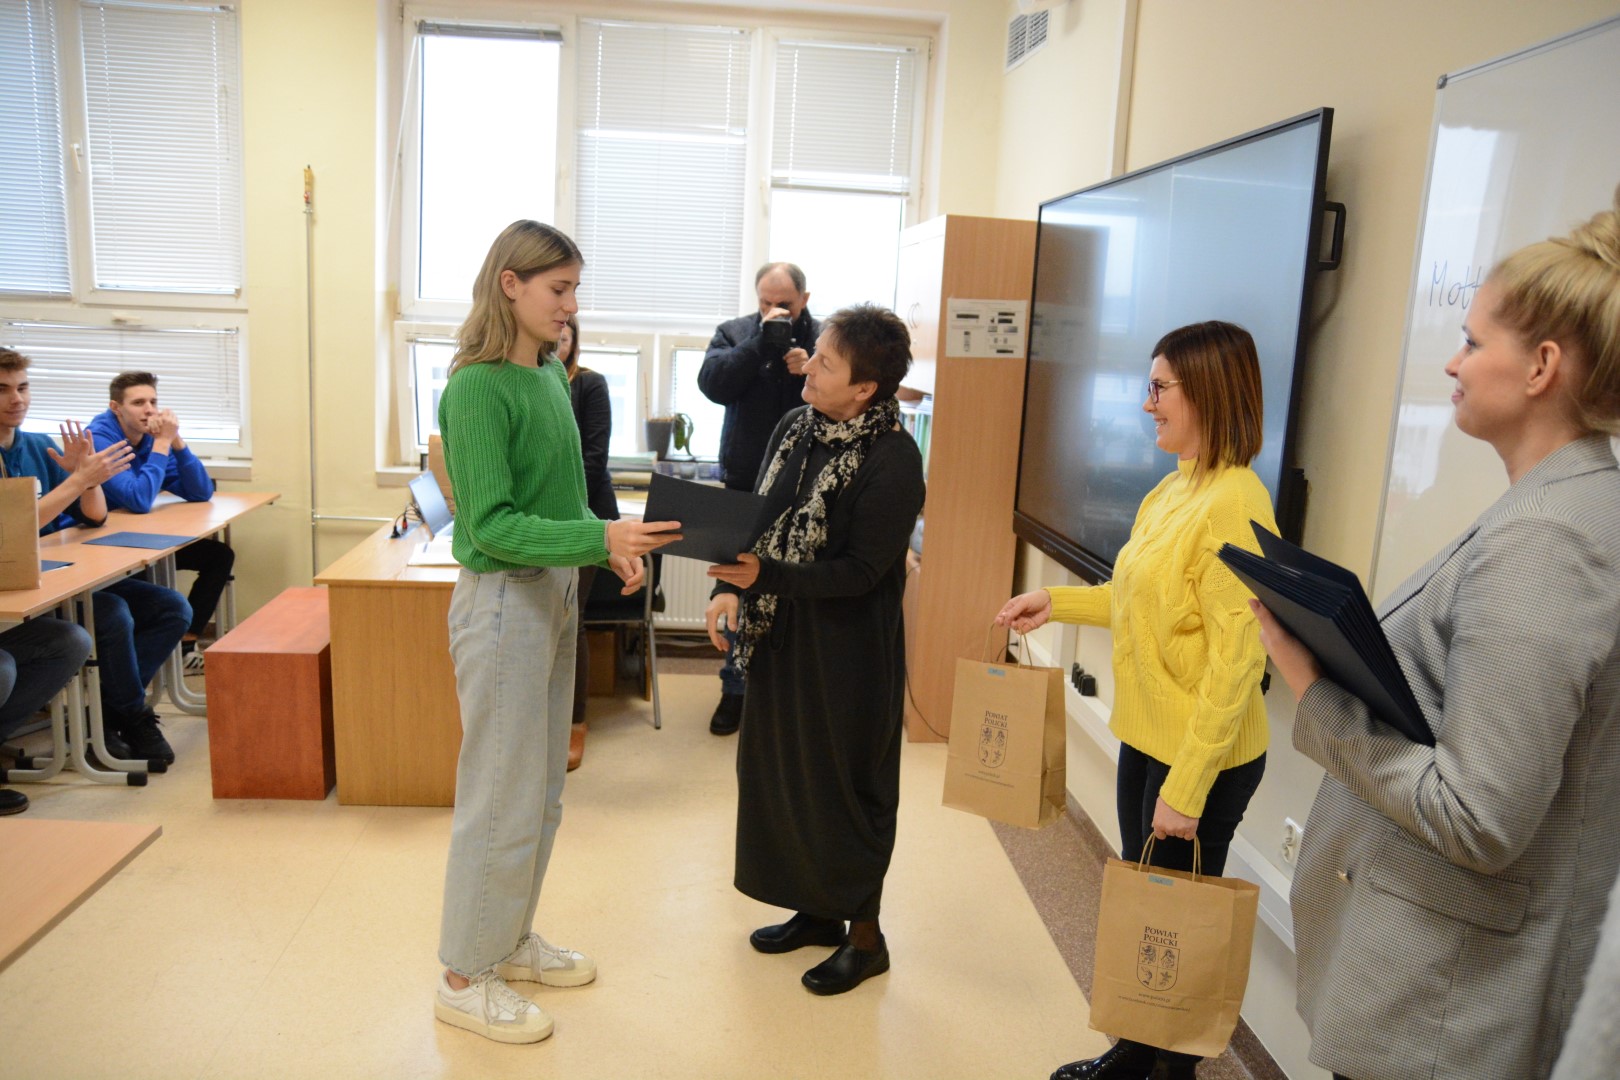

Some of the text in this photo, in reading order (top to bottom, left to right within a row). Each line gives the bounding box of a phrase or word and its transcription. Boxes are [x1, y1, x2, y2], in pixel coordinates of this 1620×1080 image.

[985, 710, 1008, 721] POWIAT
[1144, 926, 1179, 939] POWIAT
[1143, 933, 1178, 947] POLICKI
